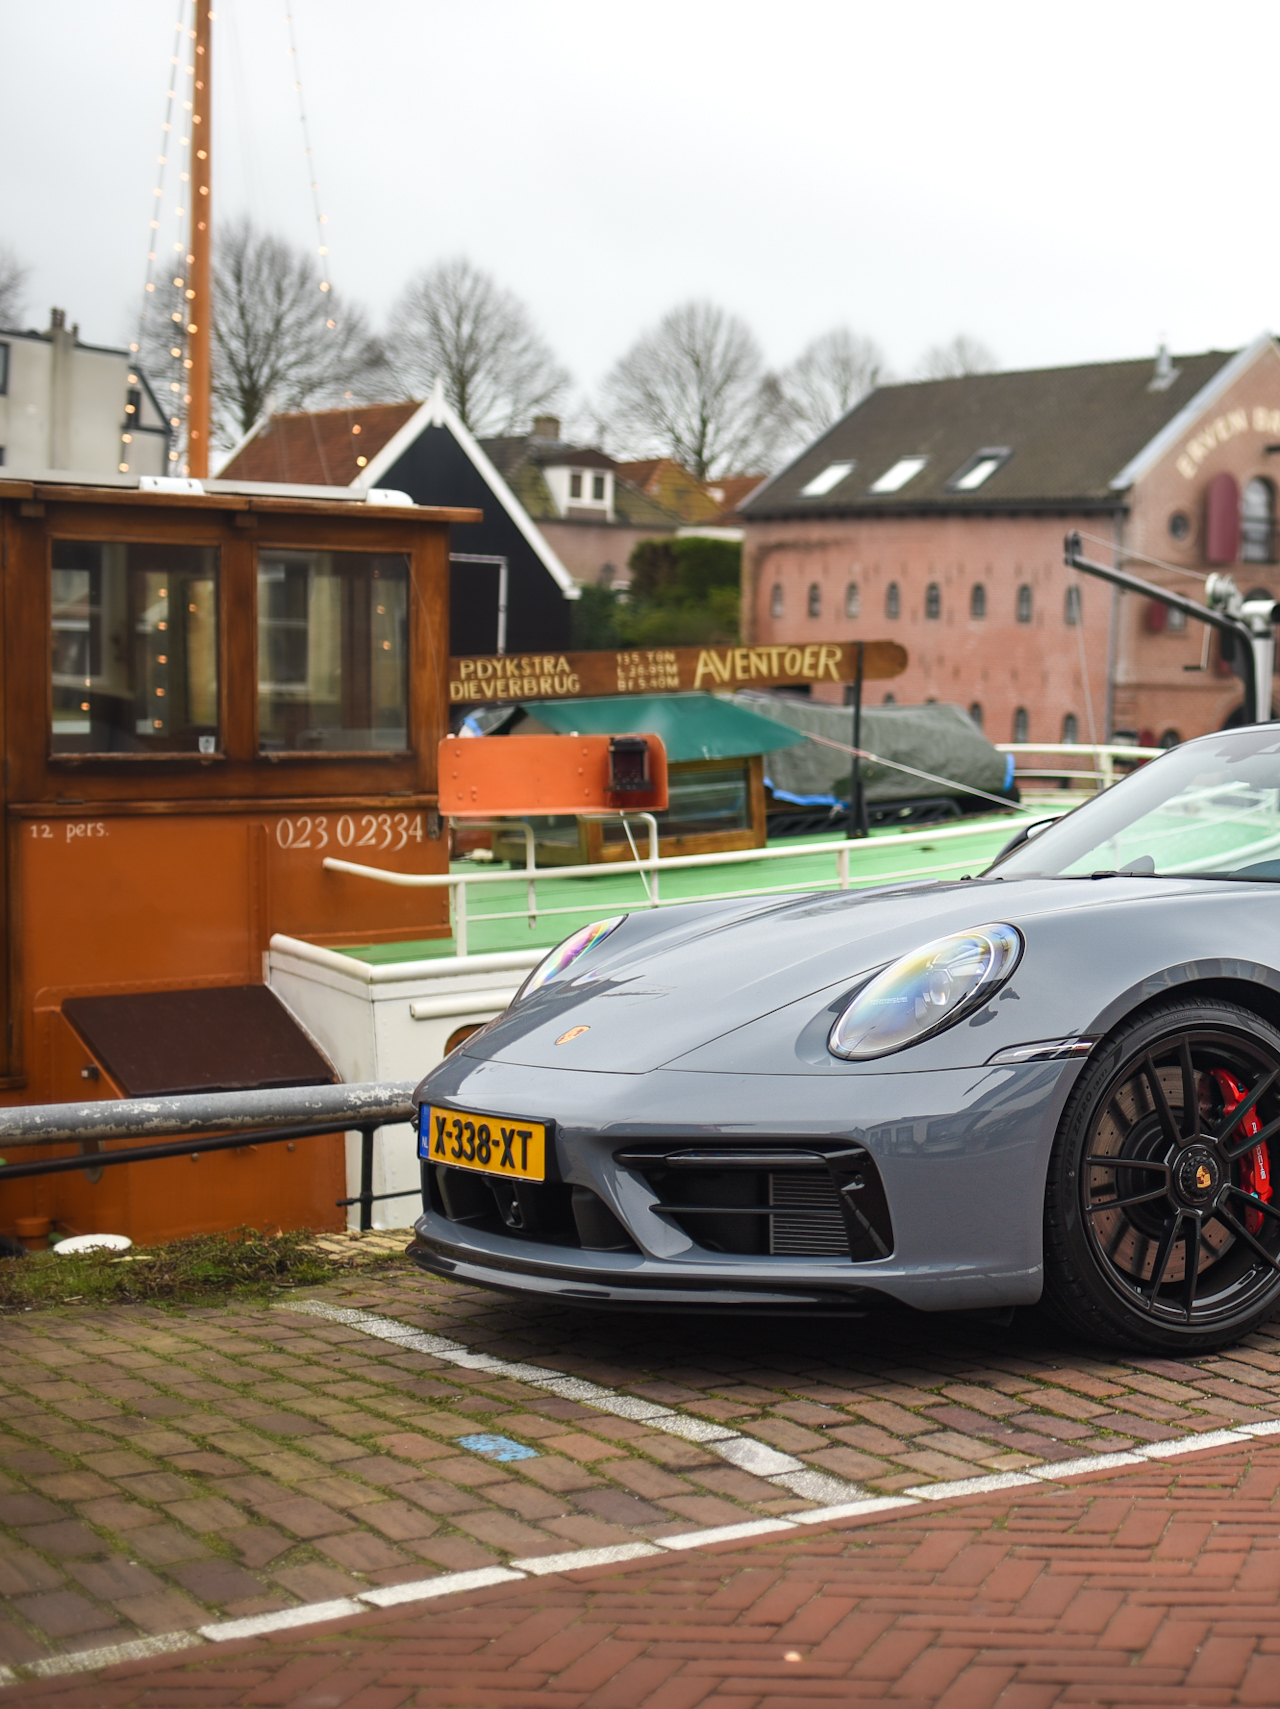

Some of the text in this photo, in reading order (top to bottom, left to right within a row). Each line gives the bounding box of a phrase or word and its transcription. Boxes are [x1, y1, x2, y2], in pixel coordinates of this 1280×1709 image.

[693, 644, 844, 690] AVENTOER
[450, 673, 580, 700] DIEVERBRUG
[30, 822, 109, 844] 12 pers.
[421, 1135, 429, 1149] NL
[434, 1115, 533, 1172] X-338-XT
